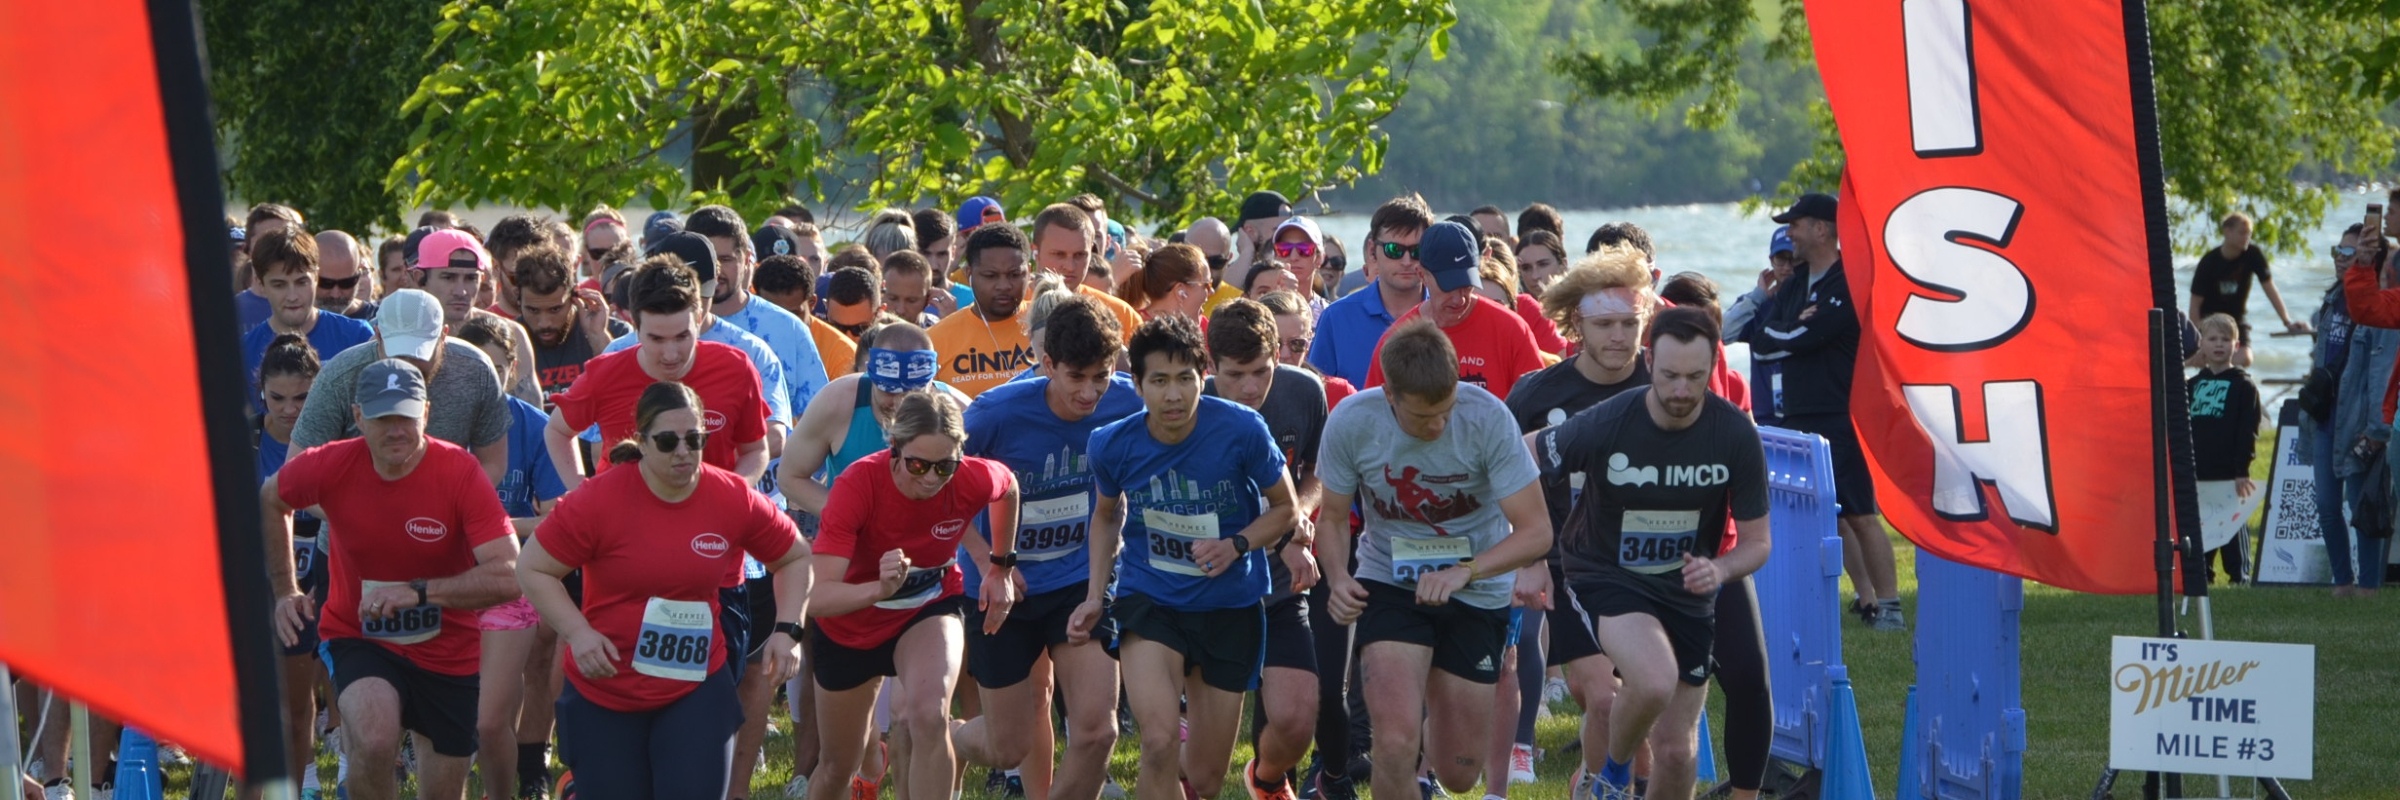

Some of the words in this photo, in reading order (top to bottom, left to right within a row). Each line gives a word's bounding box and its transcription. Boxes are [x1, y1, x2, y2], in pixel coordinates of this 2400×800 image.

[978, 372, 993, 380] FOR
[1665, 463, 1730, 487] IMCD
[409, 522, 444, 535] Henkel
[1021, 521, 1086, 550] 3994
[695, 540, 727, 551] Henkel
[1622, 535, 1695, 563] 3469
[638, 630, 709, 665] 3868
[2142, 642, 2178, 662] IT'S
[2115, 660, 2261, 716] Miller
[2187, 696, 2257, 724] TIME
[2156, 732, 2229, 759] MILE
[2237, 737, 2275, 761] #3
